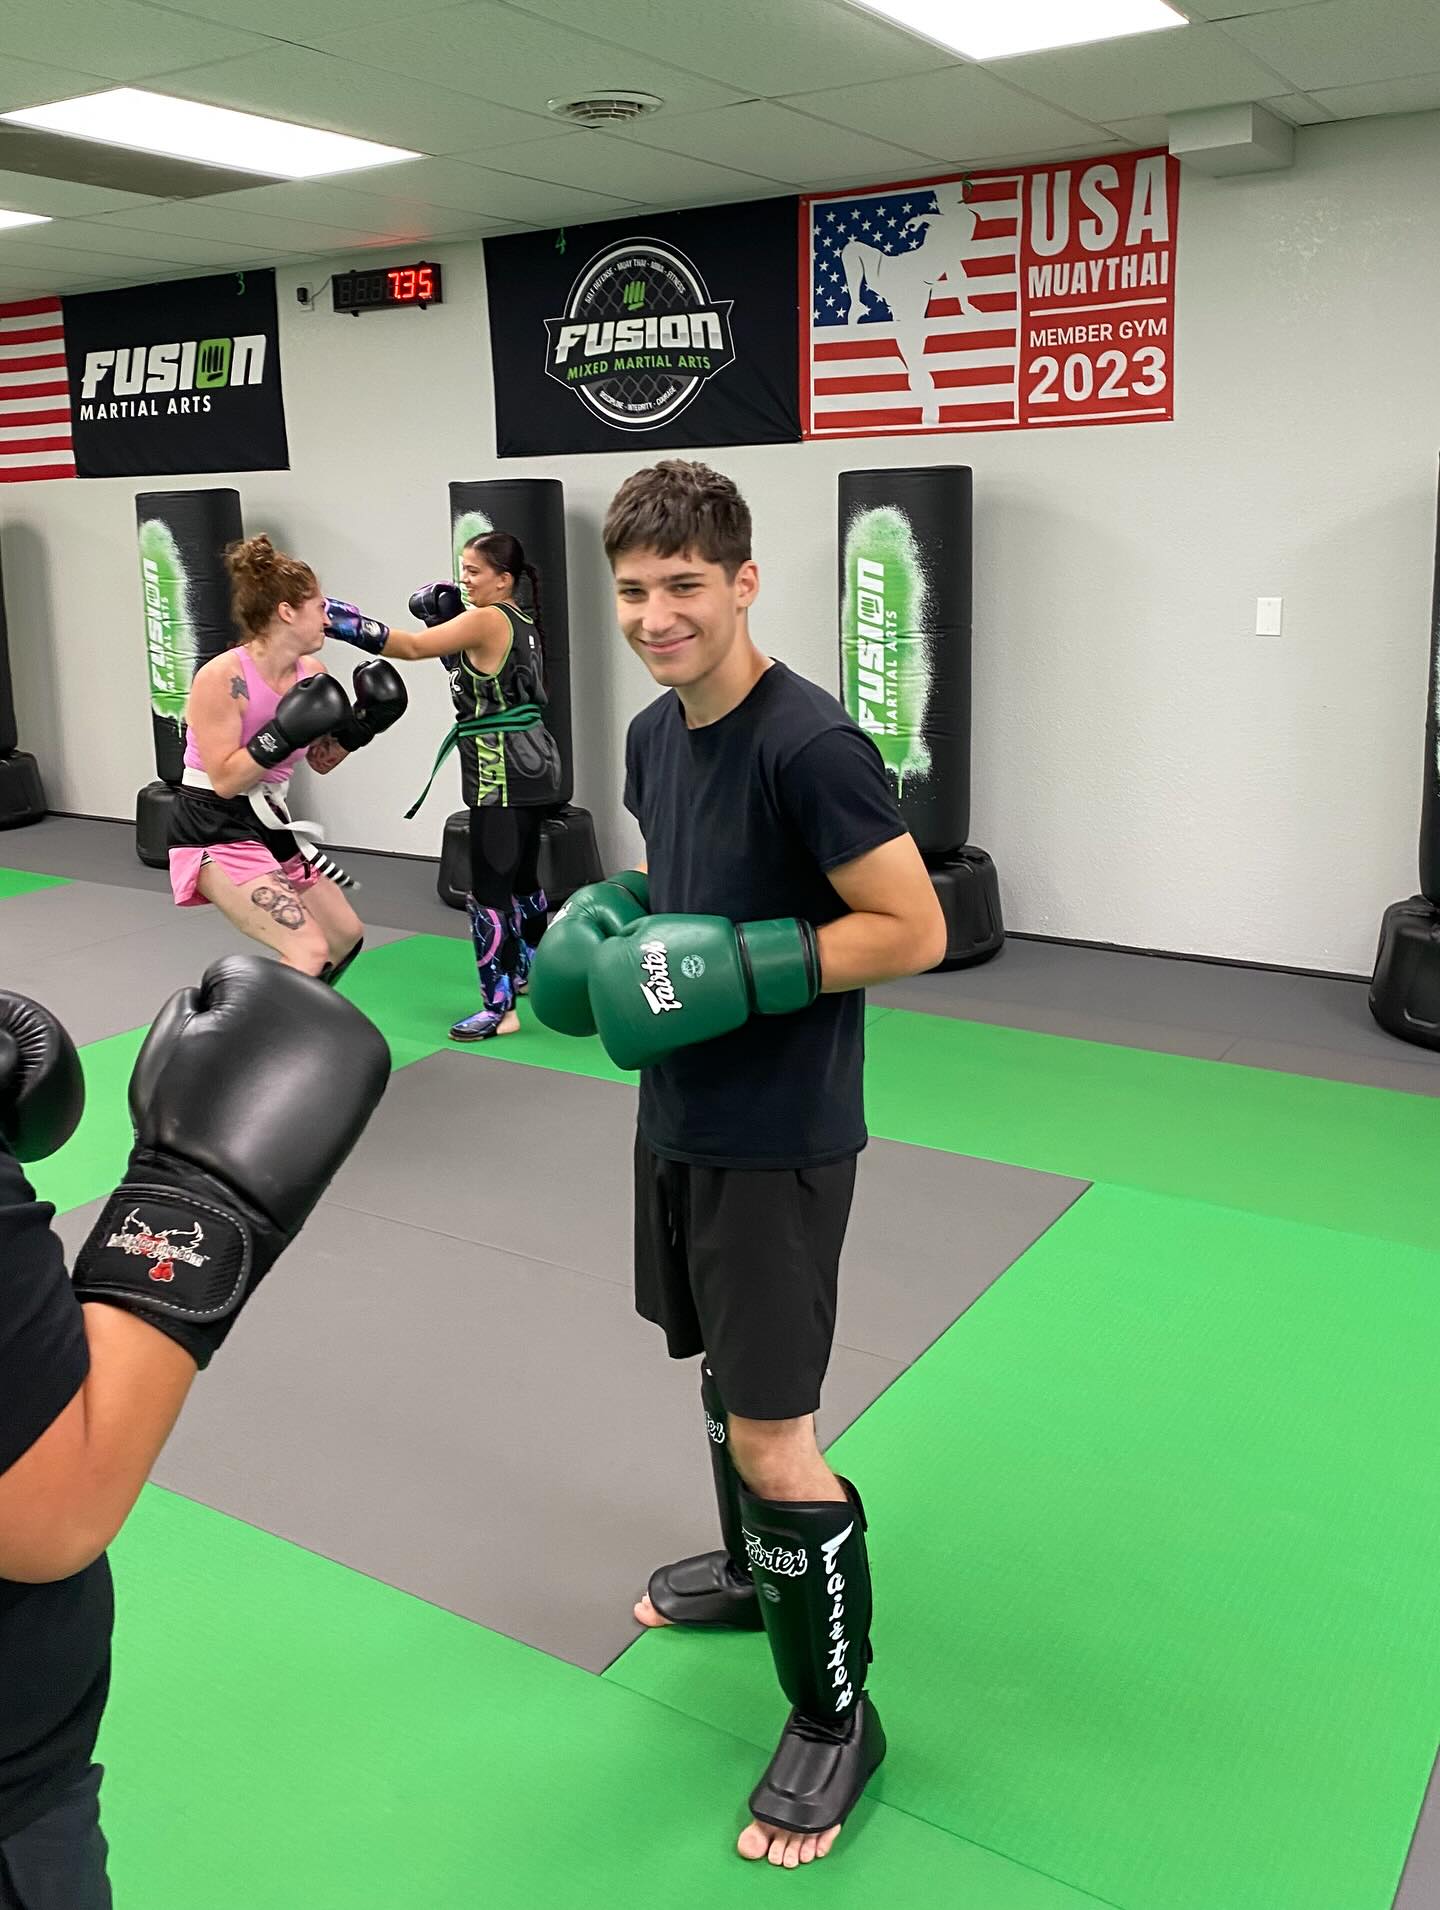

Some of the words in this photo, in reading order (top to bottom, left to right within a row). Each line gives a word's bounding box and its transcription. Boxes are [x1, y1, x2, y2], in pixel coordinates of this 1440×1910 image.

[1030, 155, 1170, 257] USA
[1028, 250, 1169, 299] MUAYTHAI
[554, 312, 724, 364] FUSION
[1029, 323, 1113, 348] MEMBER
[1118, 318, 1167, 340] GYM
[80, 334, 267, 399] FUSION
[566, 361, 609, 381] MIXED
[614, 355, 673, 371] MARTIAL
[678, 355, 711, 369] ARTS
[1028, 346, 1167, 404] 2023
[80, 399, 158, 421] MARTIAL
[167, 395, 212, 415] ARTS
[142, 557, 169, 691] FUSION
[857, 557, 884, 736] FUSION
[884, 609, 898, 652] ARTS
[163, 633, 175, 692] MARTIAL
[885, 660, 898, 736] MARTIAL
[639, 939, 683, 1015] Fairtex
